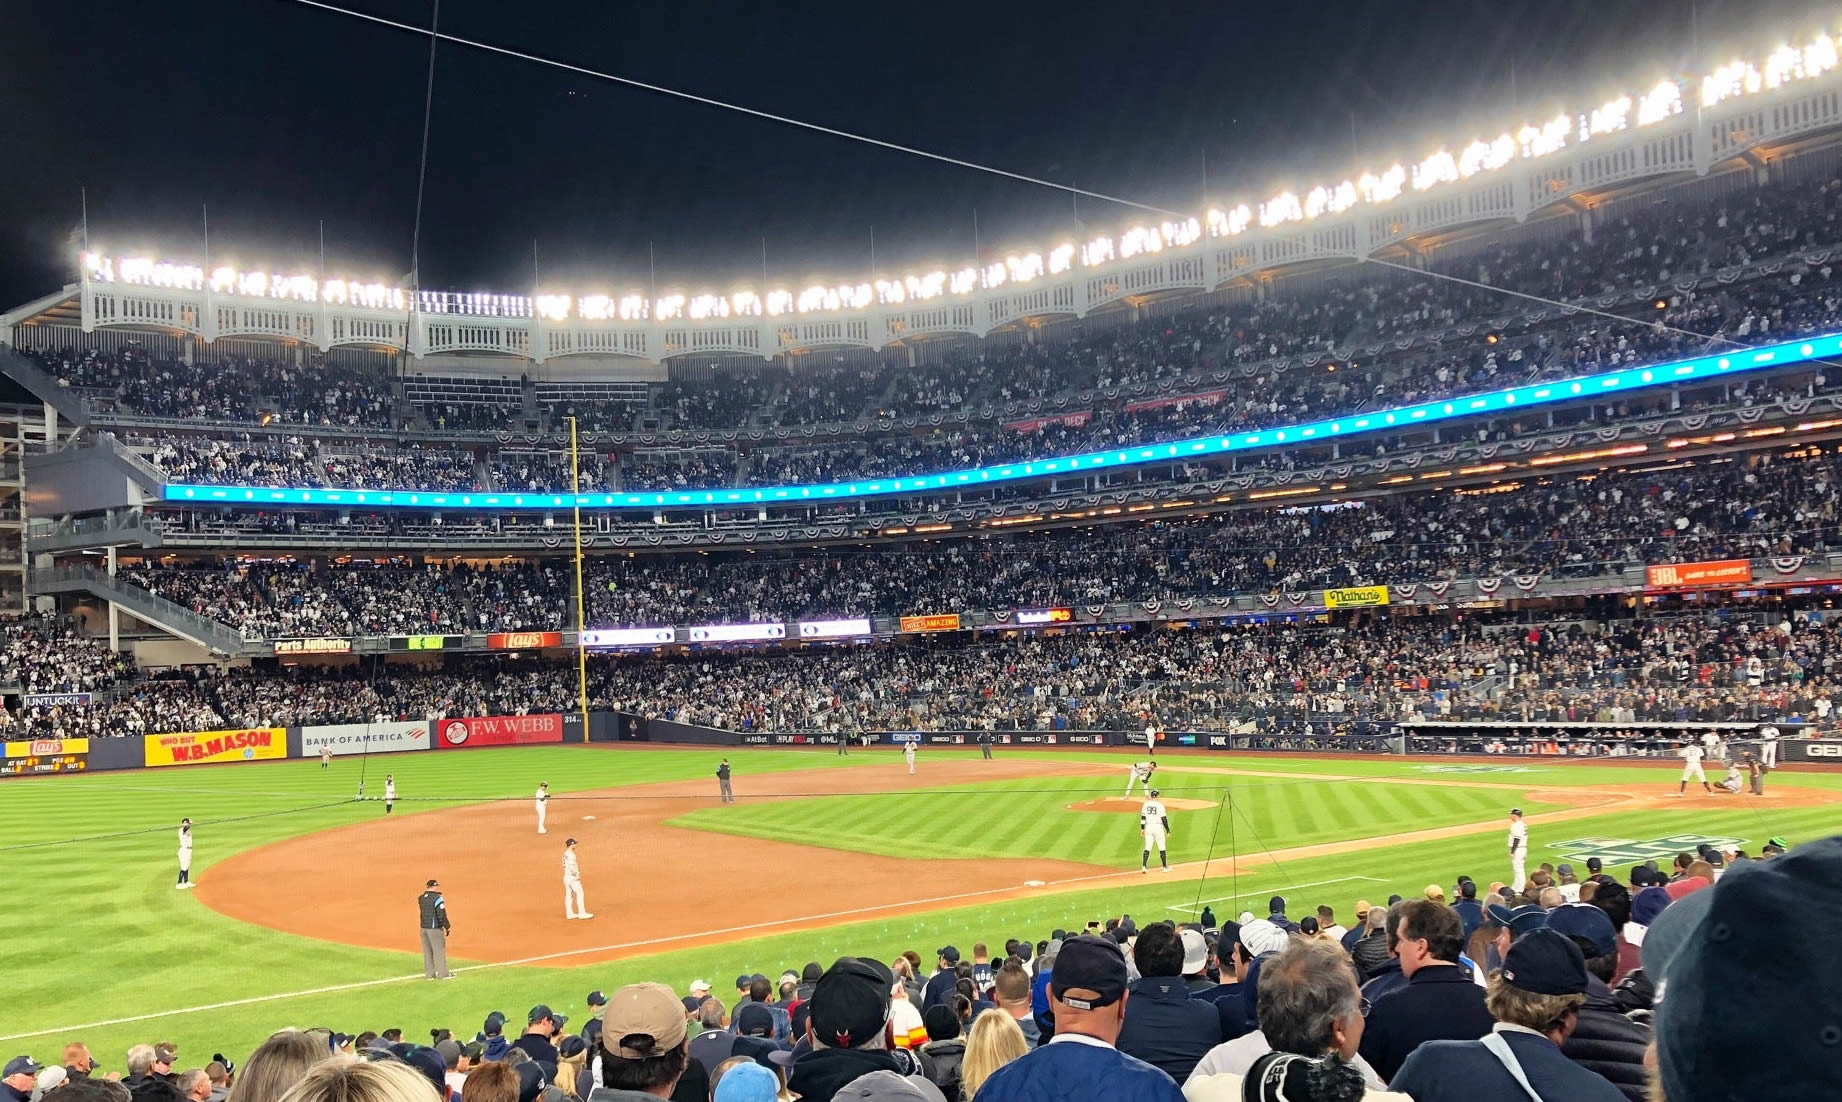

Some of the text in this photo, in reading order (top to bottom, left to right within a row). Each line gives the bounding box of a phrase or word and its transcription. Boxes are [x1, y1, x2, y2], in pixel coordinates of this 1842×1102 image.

[926, 618, 957, 627] AMAZING
[274, 639, 351, 651] Parts Authority
[564, 716, 577, 724] 314
[471, 717, 555, 736] F.W. WEBB
[306, 733, 403, 746] BANK OF AMERICA
[1210, 736, 1226, 746] FOX
[1146, 806, 1157, 815] 99
